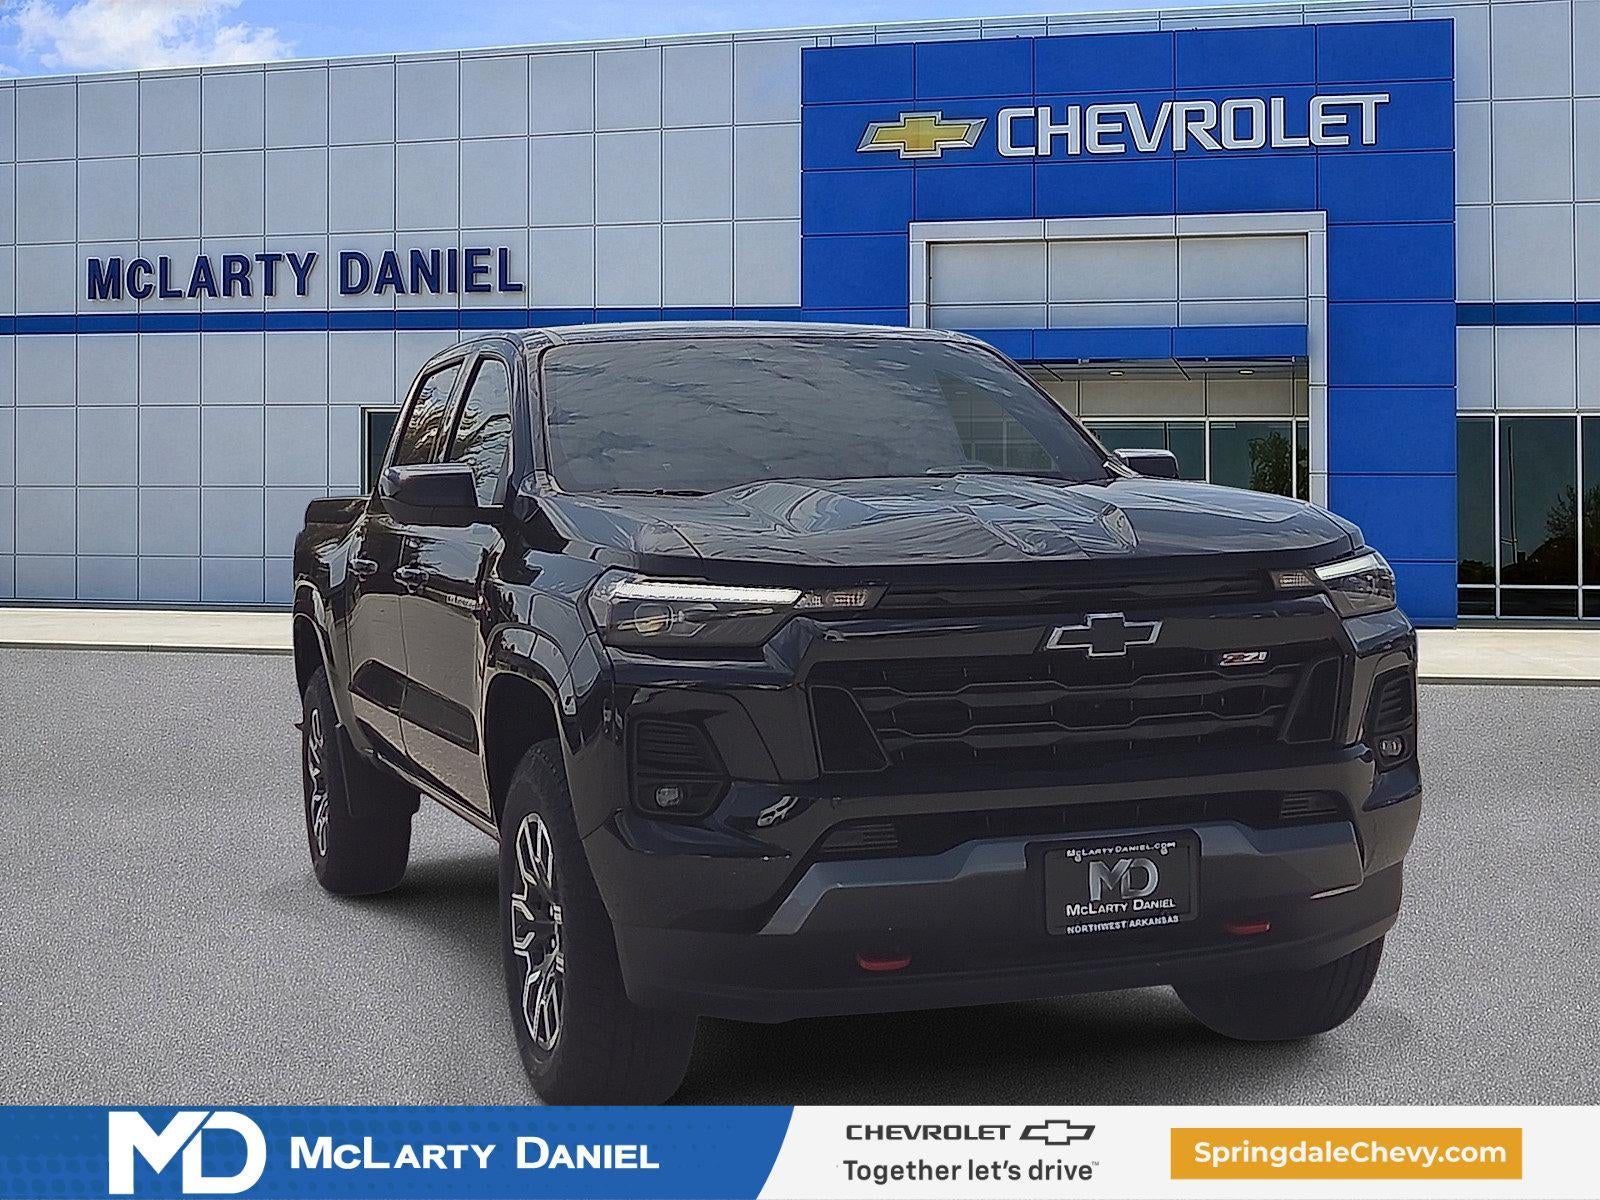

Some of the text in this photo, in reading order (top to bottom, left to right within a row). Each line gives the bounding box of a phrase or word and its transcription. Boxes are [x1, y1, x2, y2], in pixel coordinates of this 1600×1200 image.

[997, 94, 1390, 159] CHEVROLET
[338, 246, 525, 296] DANIEL
[1089, 857, 1159, 901] MD
[1066, 915, 1179, 935] NORTHWEST ARKANSAS
[1133, 898, 1176, 911] DANIEL
